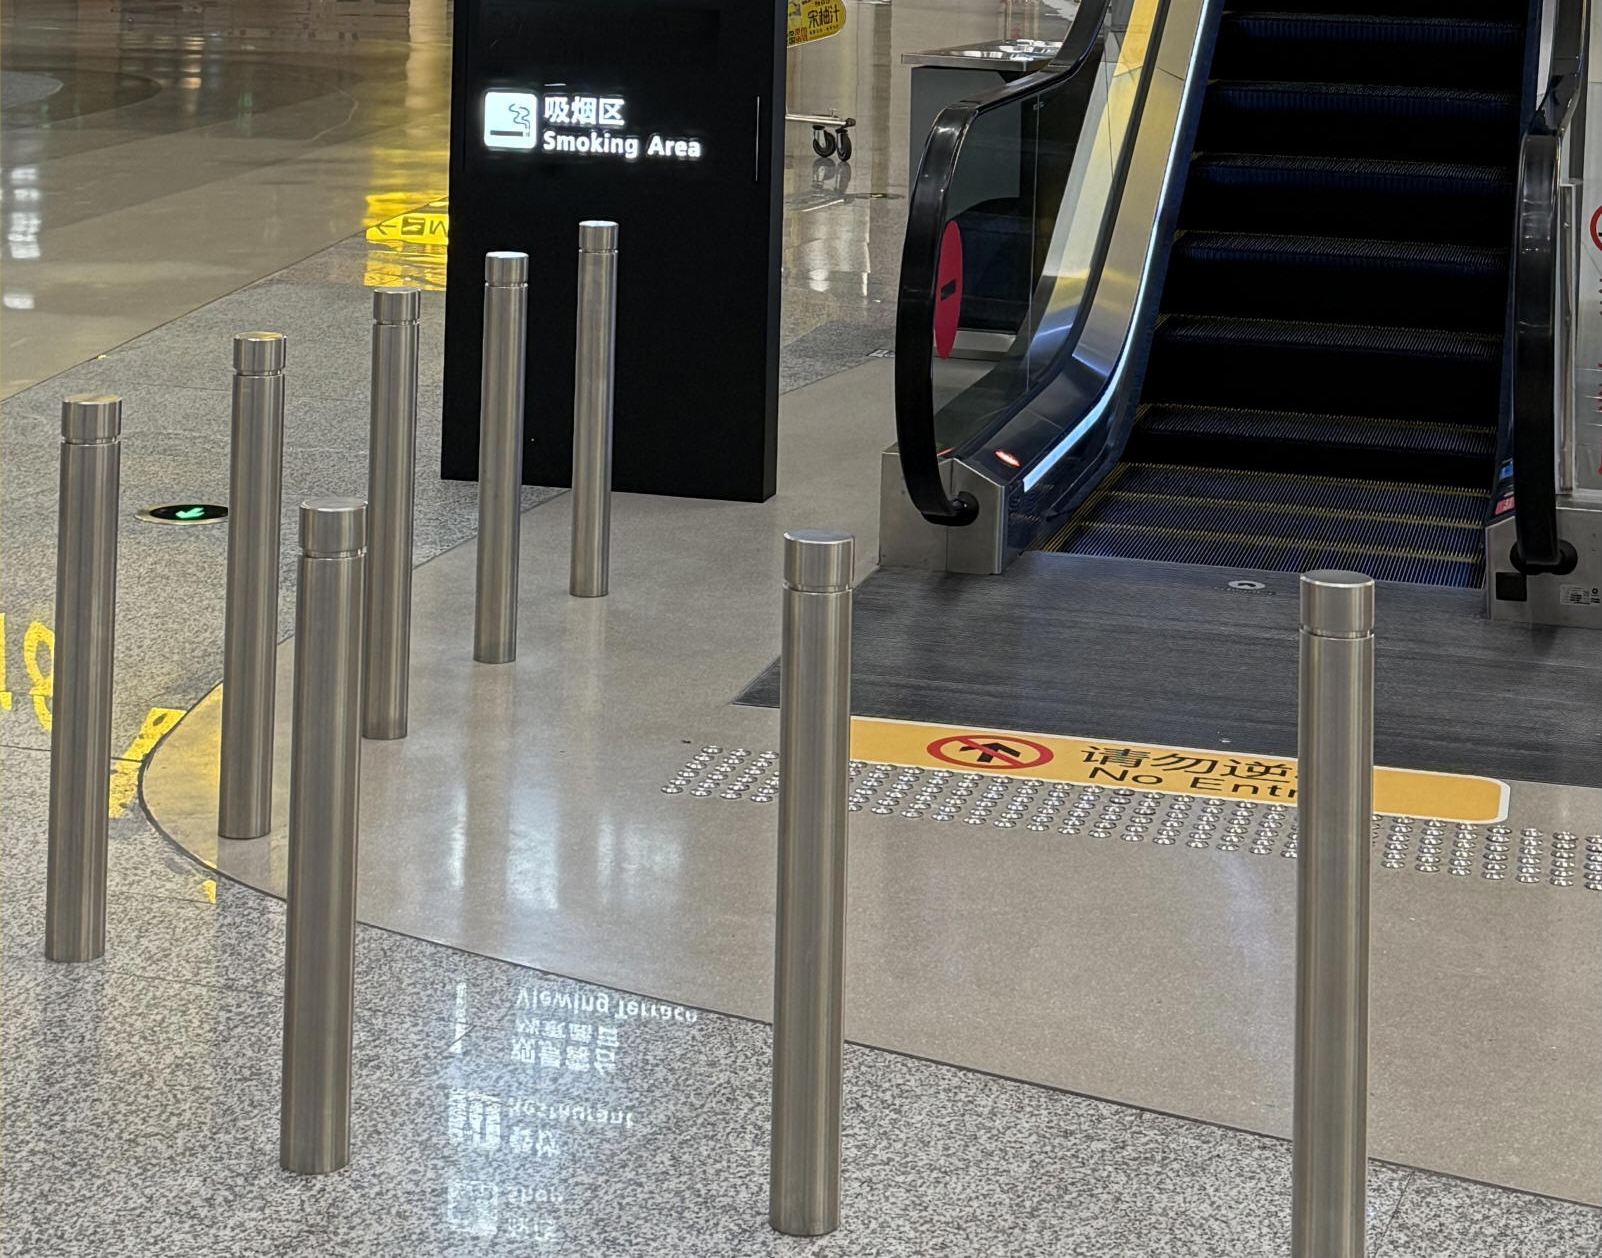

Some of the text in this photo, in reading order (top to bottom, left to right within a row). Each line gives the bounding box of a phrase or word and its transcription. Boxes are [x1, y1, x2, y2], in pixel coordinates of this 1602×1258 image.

[544, 96, 625, 128] 吸烟区
[543, 129, 701, 159] Smoking Area
[1081, 745, 1298, 784] 请勿逆
[1089, 766, 1298, 799] No Entr
